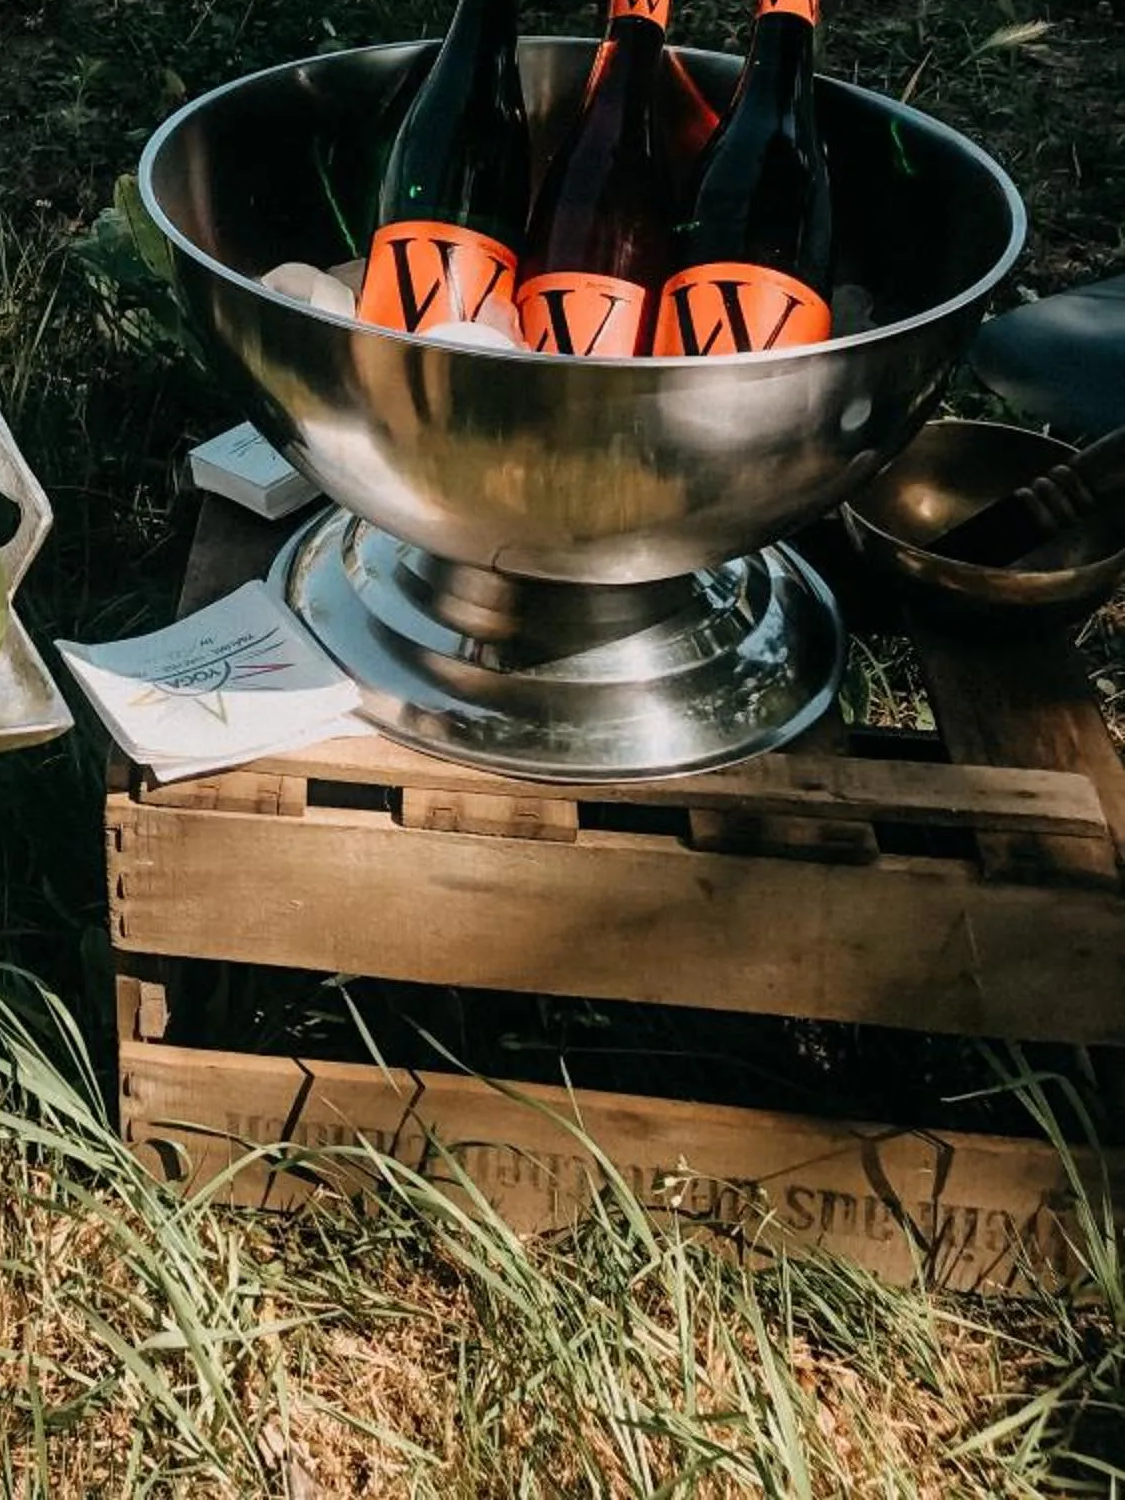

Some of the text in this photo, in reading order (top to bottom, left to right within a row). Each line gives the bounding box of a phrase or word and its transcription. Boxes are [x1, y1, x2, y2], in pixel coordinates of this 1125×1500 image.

[387, 238, 509, 333] W
[669, 280, 805, 356] W
[165, 667, 222, 689] YOGA
